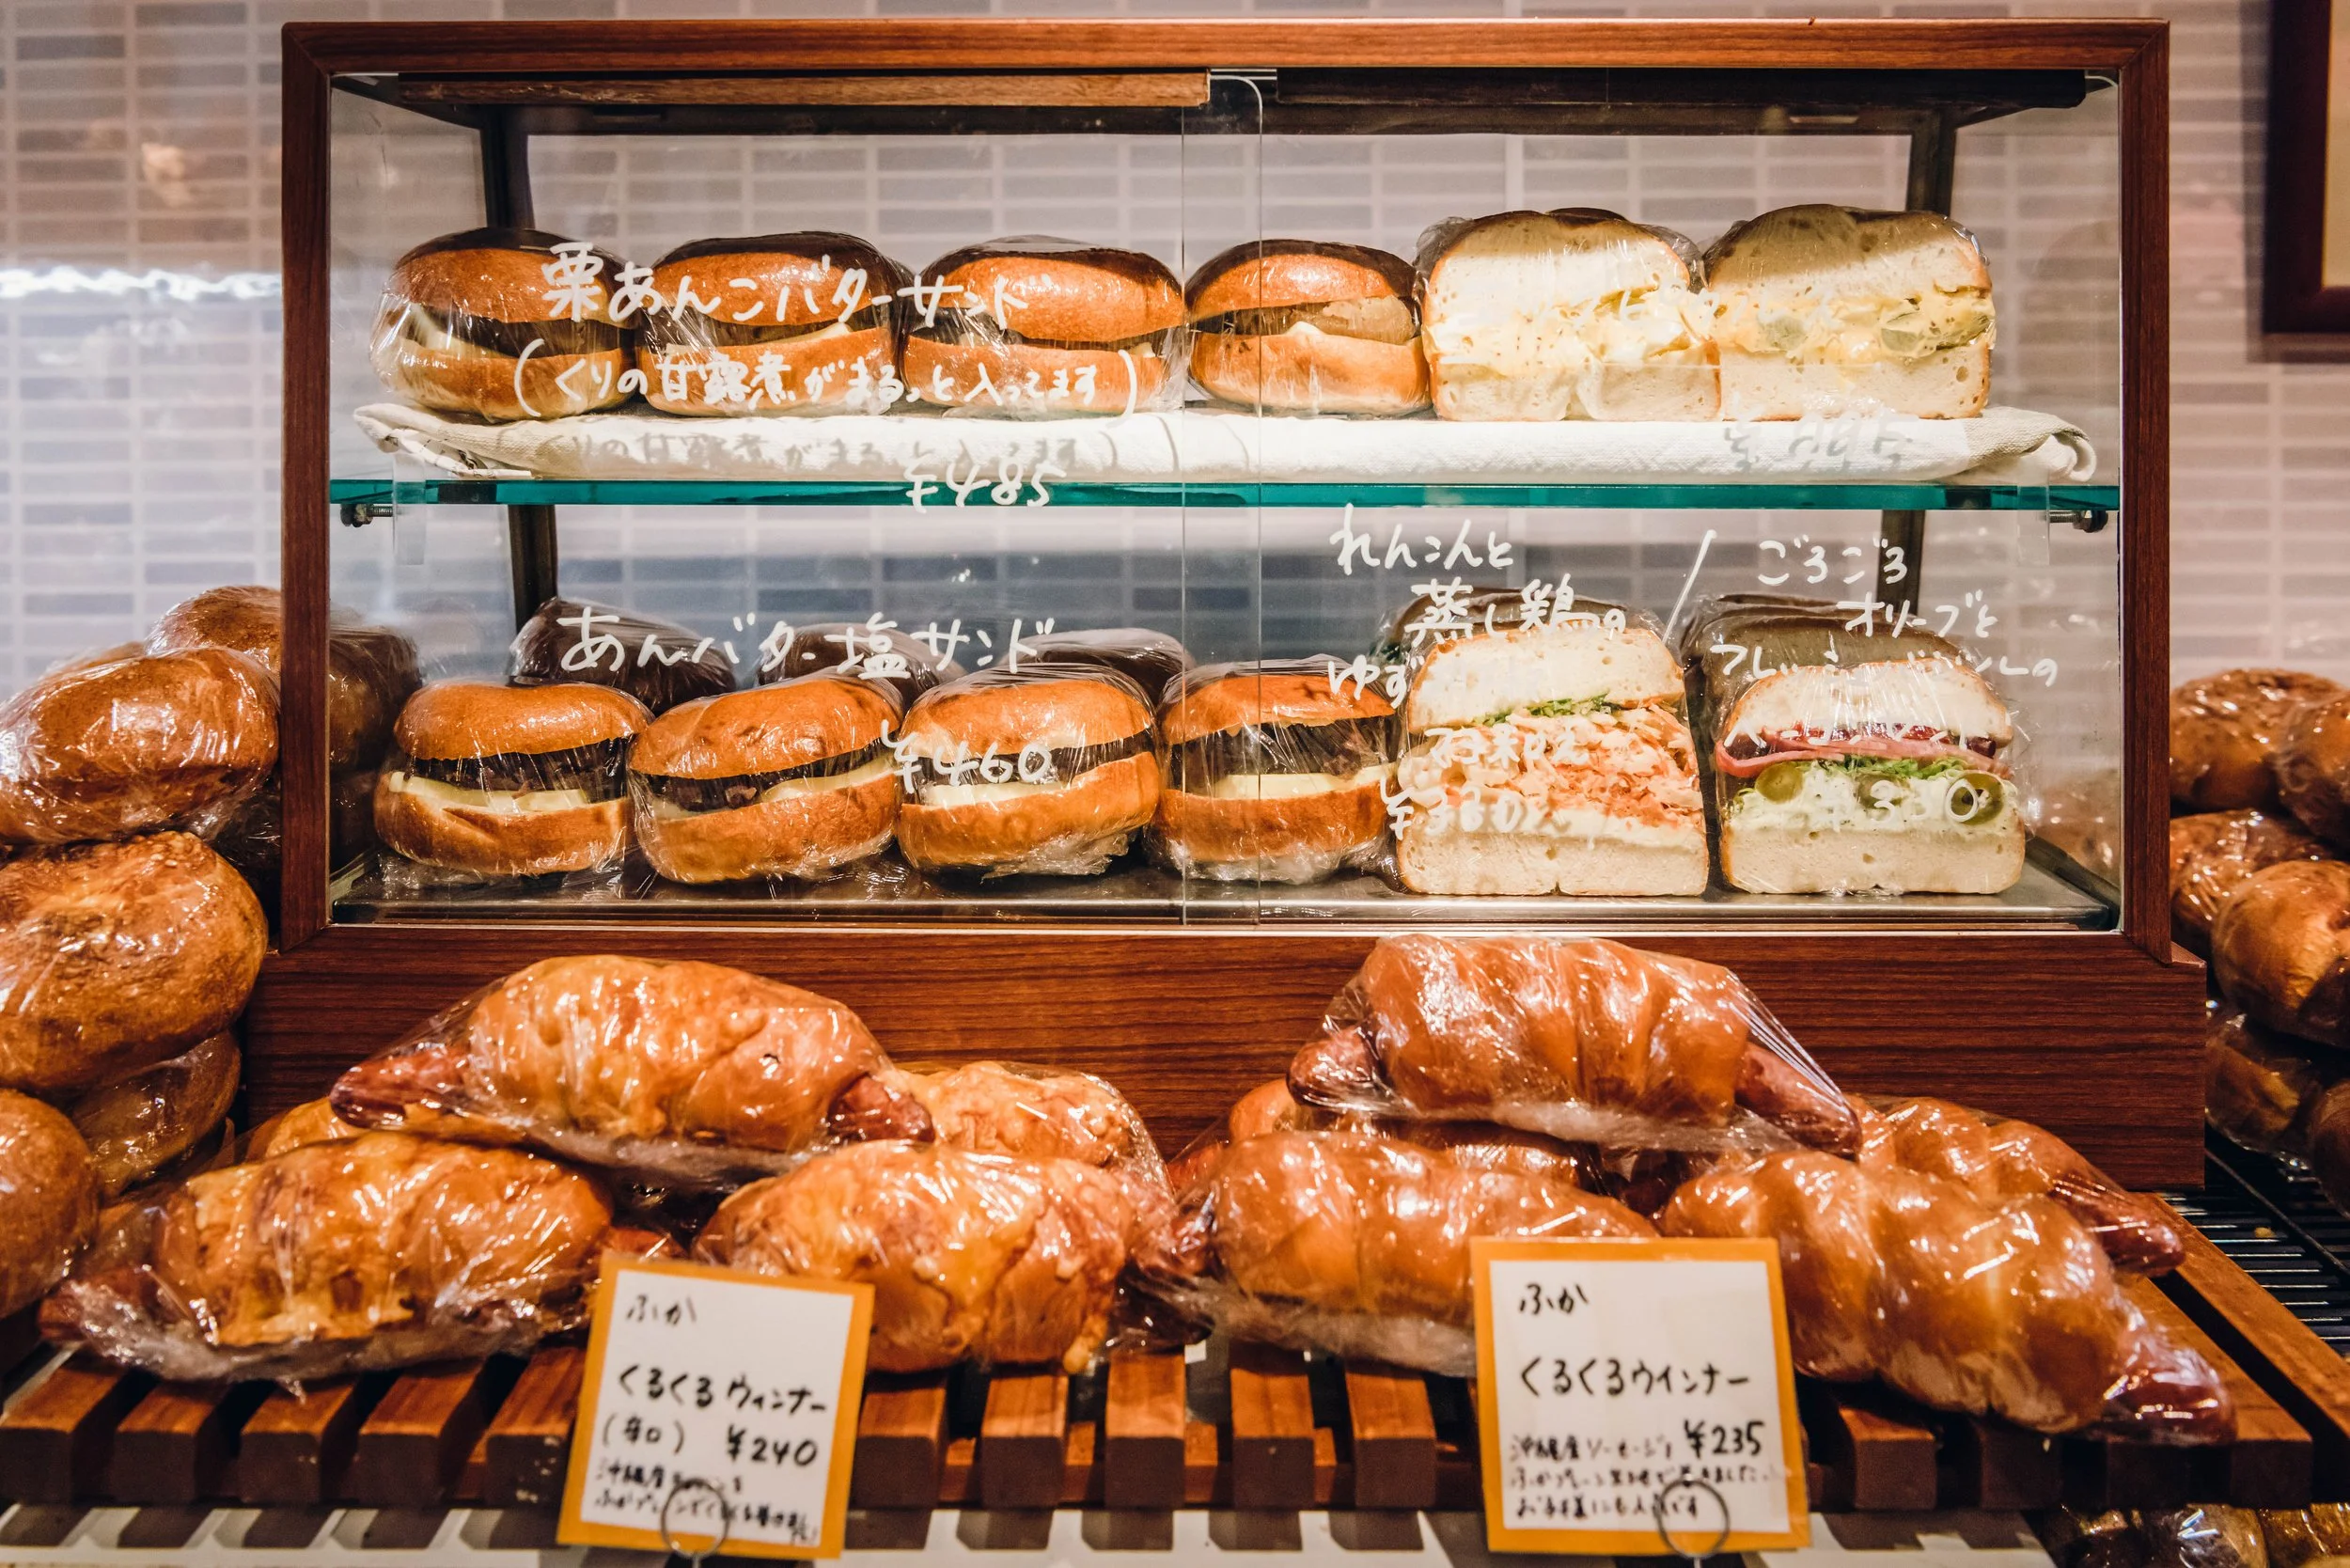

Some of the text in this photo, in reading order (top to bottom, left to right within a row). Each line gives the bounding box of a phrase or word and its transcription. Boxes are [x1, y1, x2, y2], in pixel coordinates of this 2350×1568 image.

[903, 453, 1067, 513] ¥485
[1329, 505, 1514, 575] れんこんと
[1758, 532, 1907, 585] ごろごろ
[1837, 589, 1998, 638] オリーブと
[557, 605, 1056, 680] あんバター塩サンド
[880, 718, 1053, 794] ¥460
[728, 1423, 818, 1467] ¥240
[1684, 1419, 1765, 1459] ¥235
